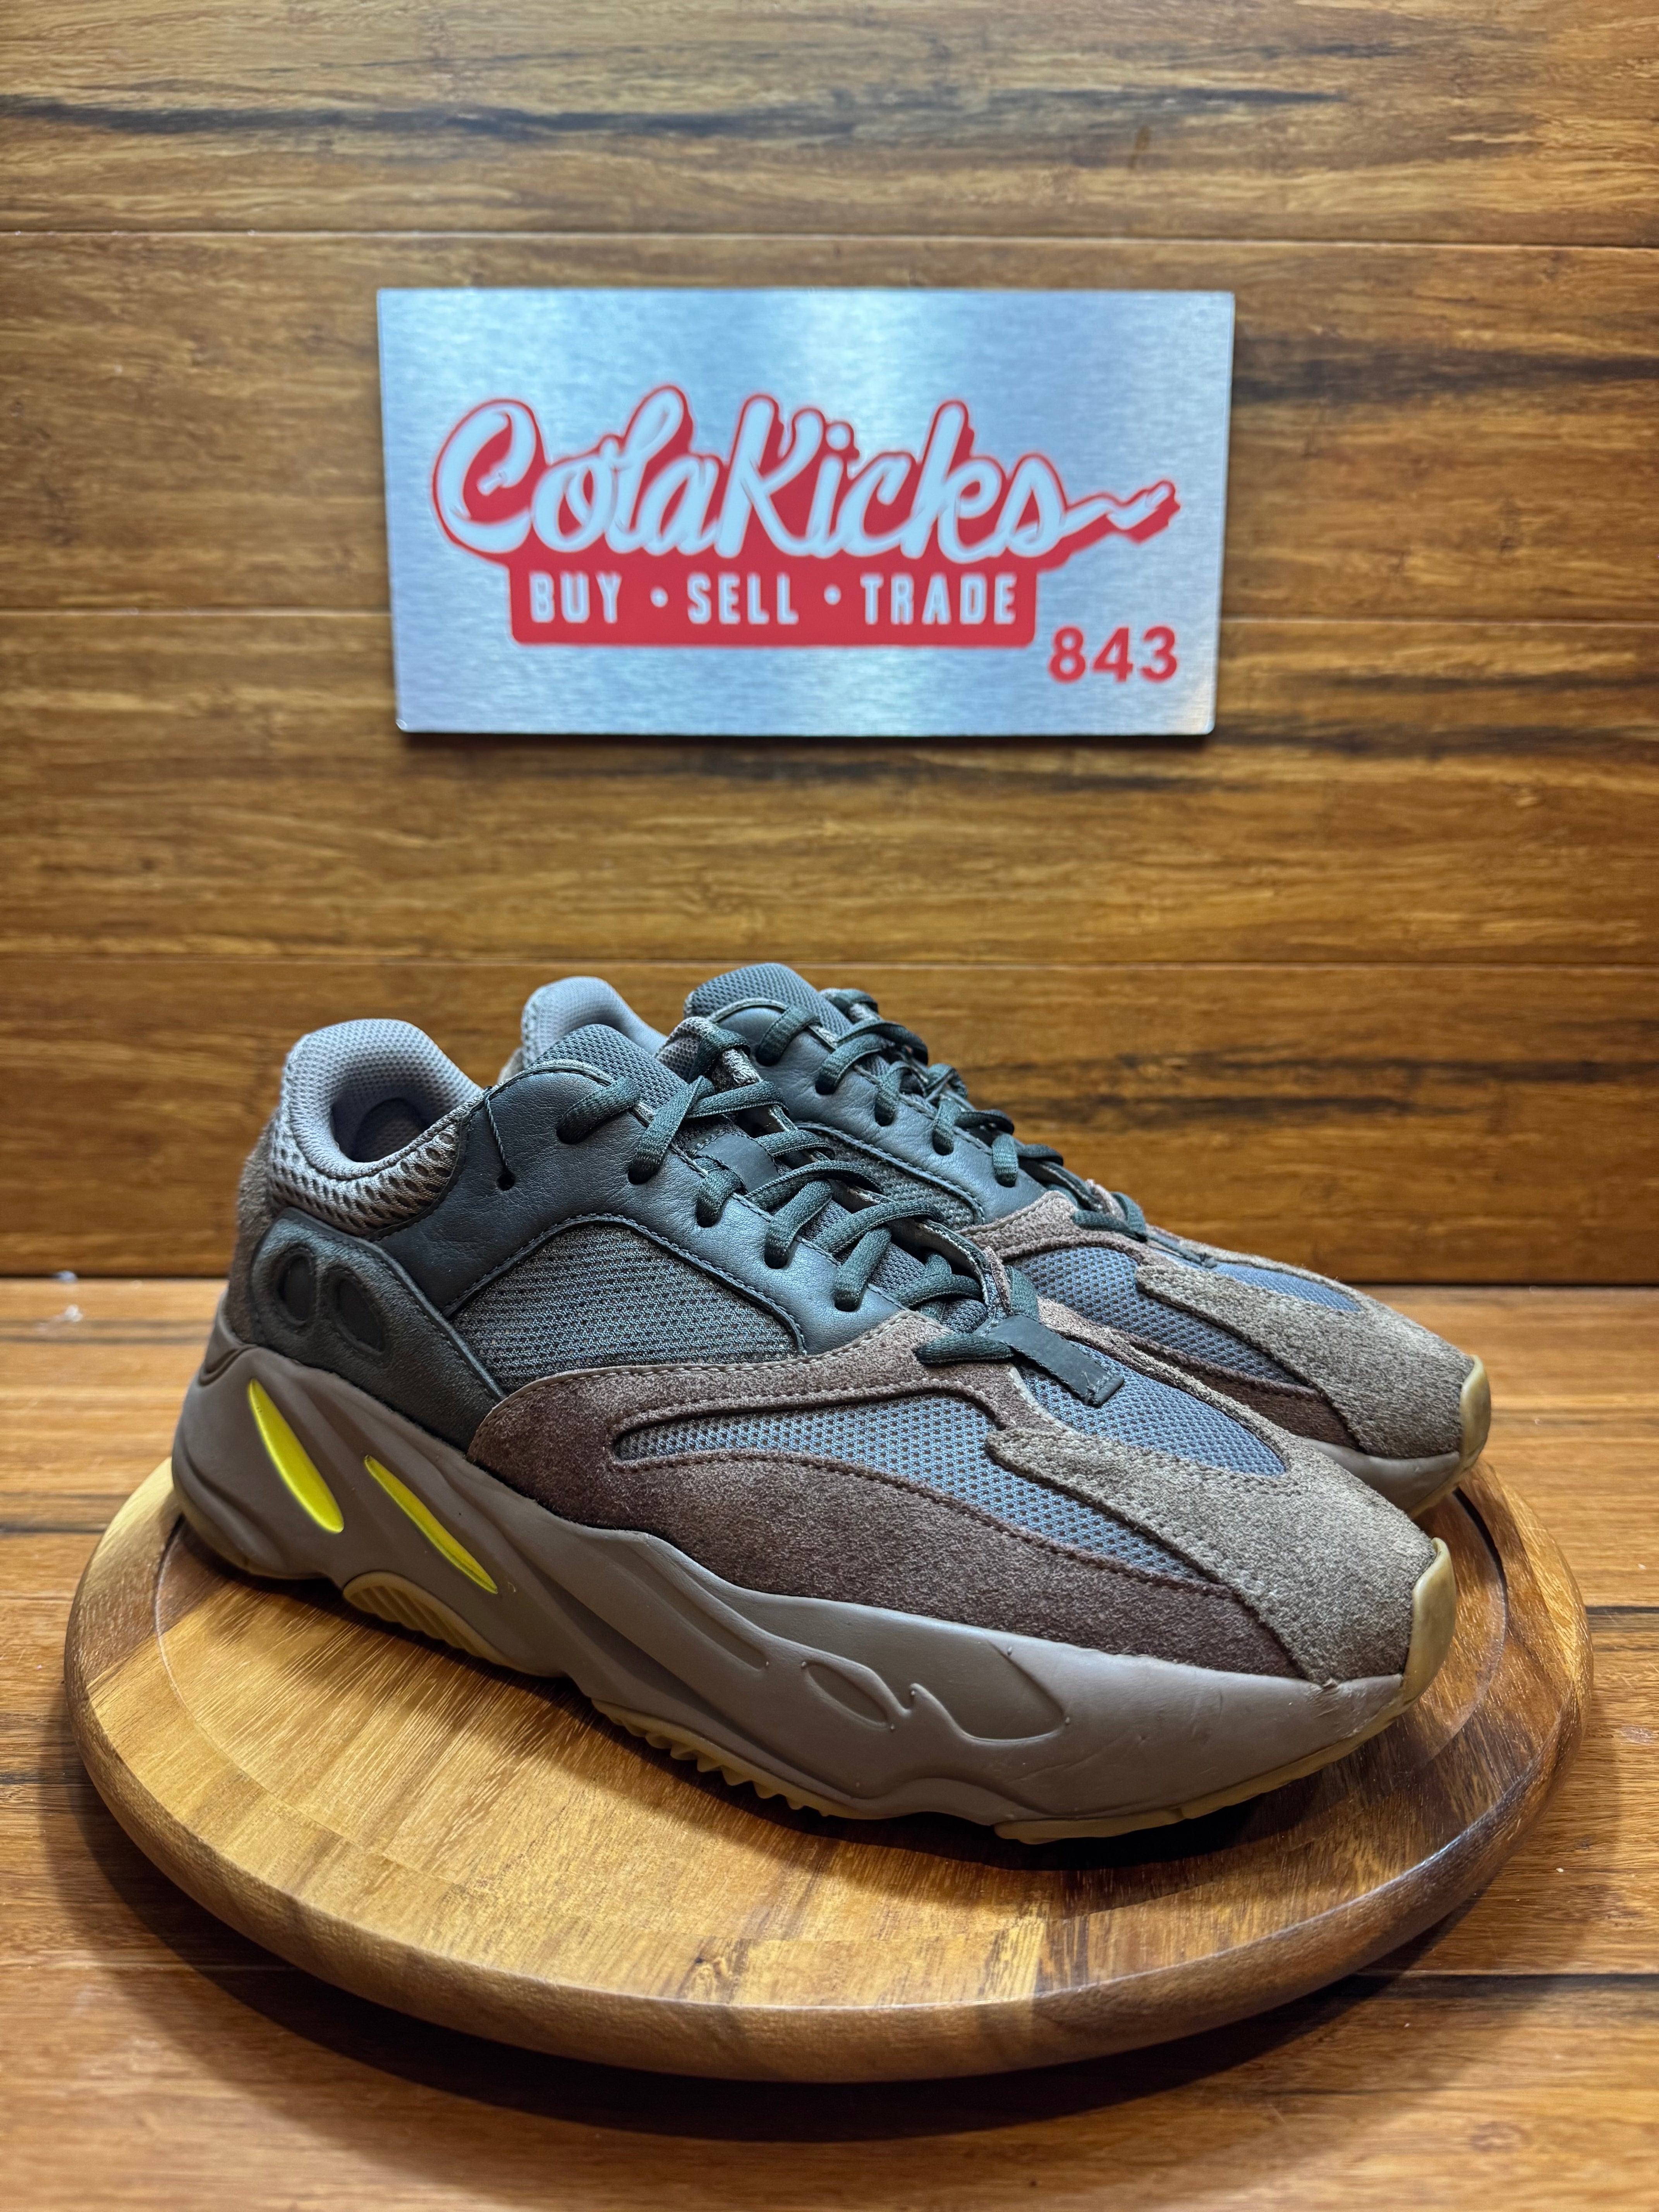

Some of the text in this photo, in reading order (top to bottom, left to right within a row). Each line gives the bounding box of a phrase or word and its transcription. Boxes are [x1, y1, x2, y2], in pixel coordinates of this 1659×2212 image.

[433, 385, 1180, 562] ColaKicks
[529, 572, 1016, 625] BUY SELL TRADE
[1048, 625, 1178, 683] 843
